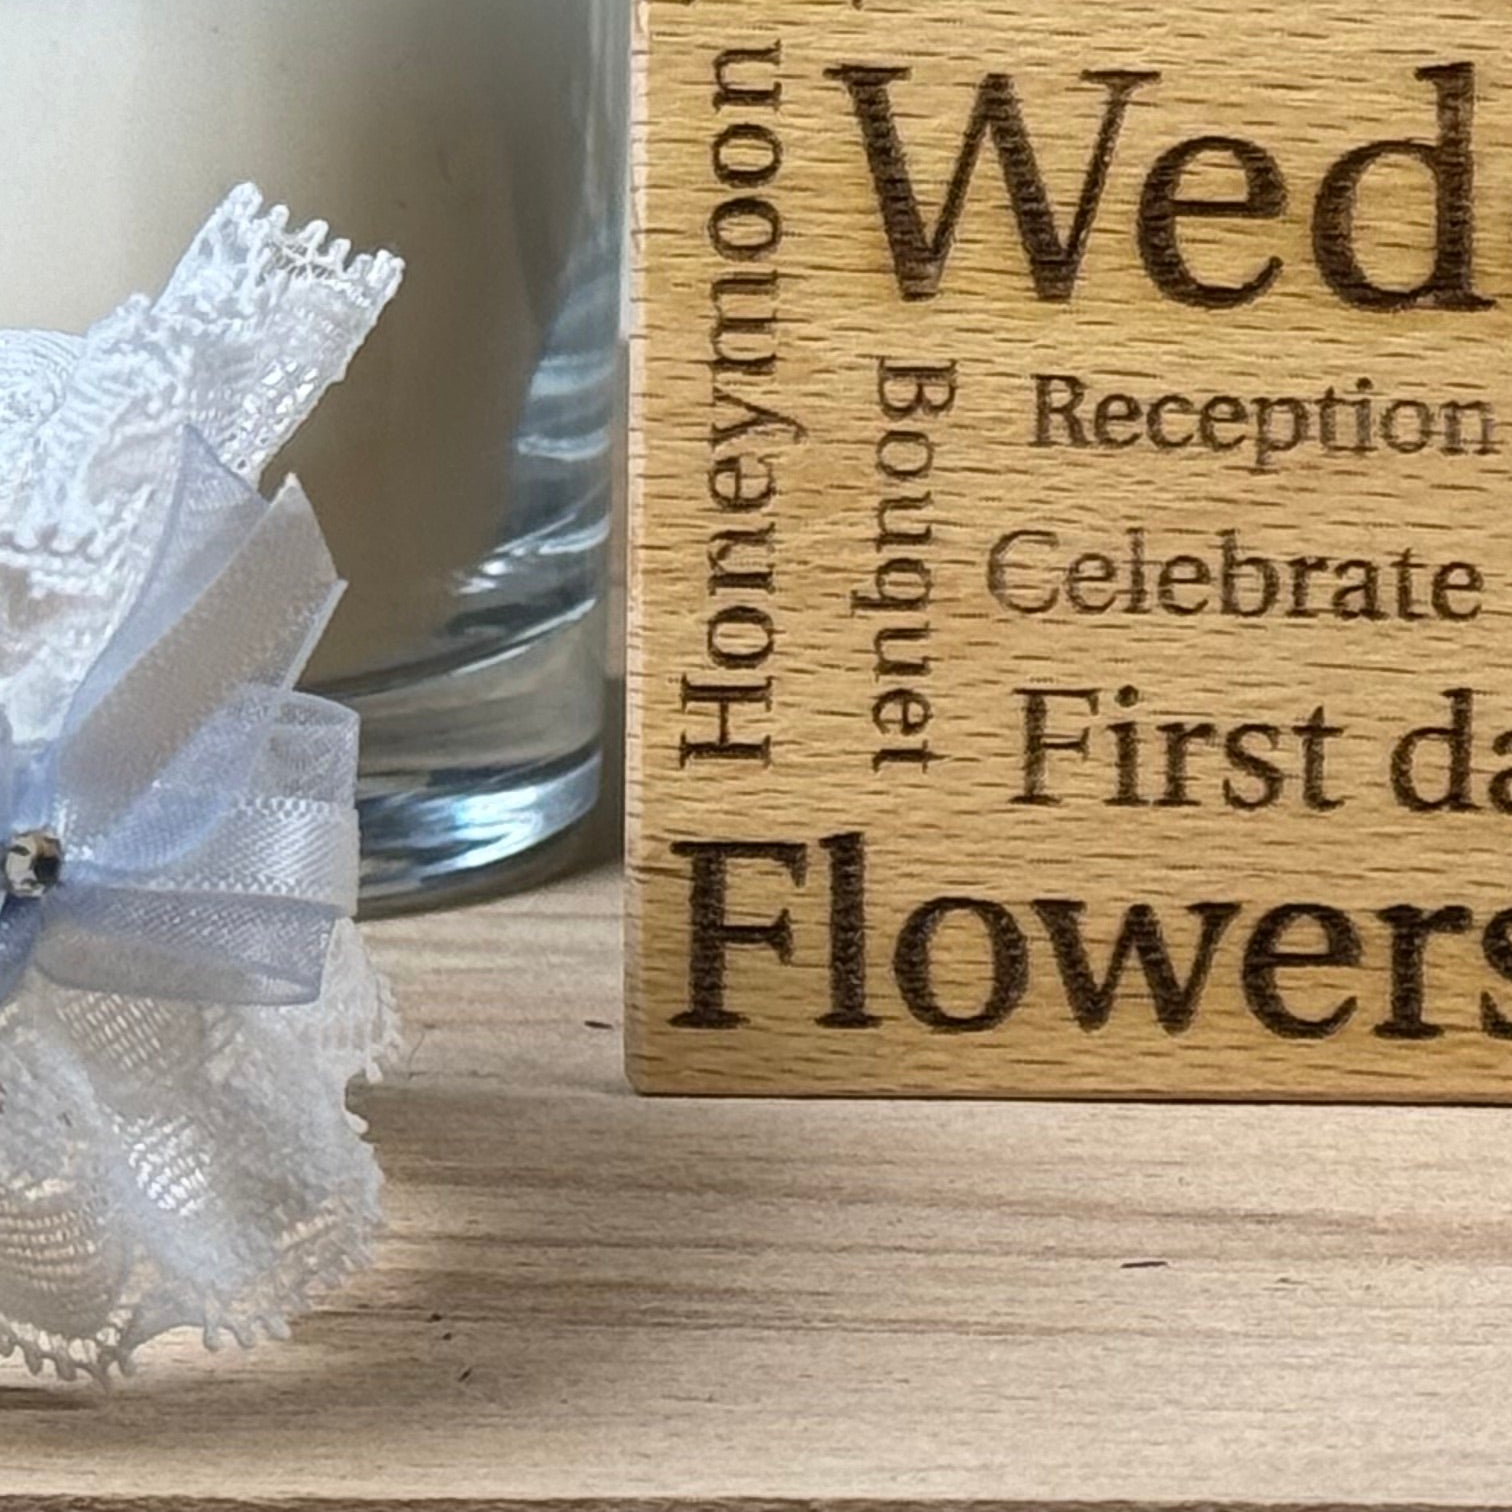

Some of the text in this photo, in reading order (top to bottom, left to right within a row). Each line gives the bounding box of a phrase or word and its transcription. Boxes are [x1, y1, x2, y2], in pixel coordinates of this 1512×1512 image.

[677, 39, 808, 771] Honeymoon
[1029, 372, 1498, 475] Reception
[850, 355, 958, 774] Bouquet
[986, 526, 1485, 624] Celebrate
[1009, 685, 1346, 813] First
